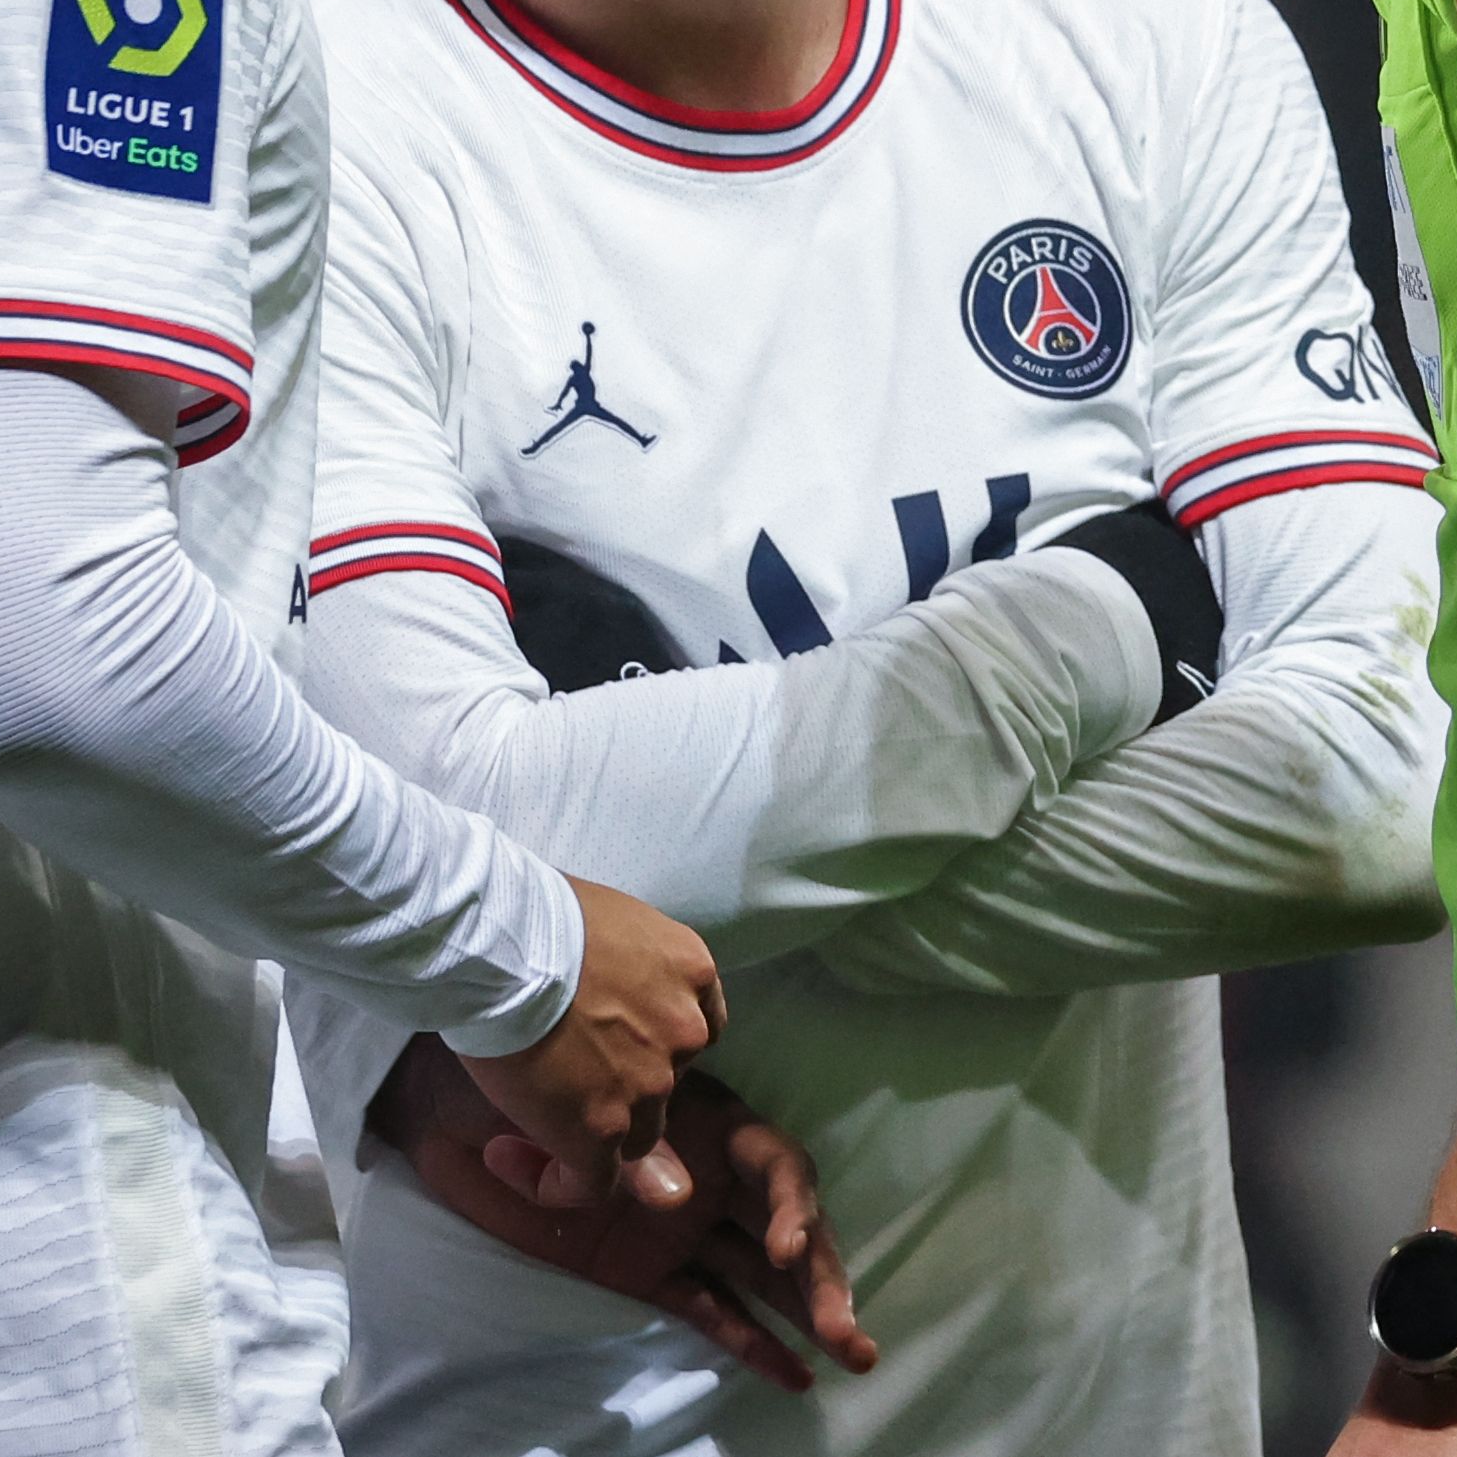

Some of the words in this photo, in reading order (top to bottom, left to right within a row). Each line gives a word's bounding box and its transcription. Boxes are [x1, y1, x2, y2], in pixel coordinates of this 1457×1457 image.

[66, 87, 171, 128] LIGUE
[179, 106, 194, 131] 1
[56, 124, 123, 160] Uber
[127, 137, 198, 173] Eats
[986, 236, 1093, 284] PARIS
